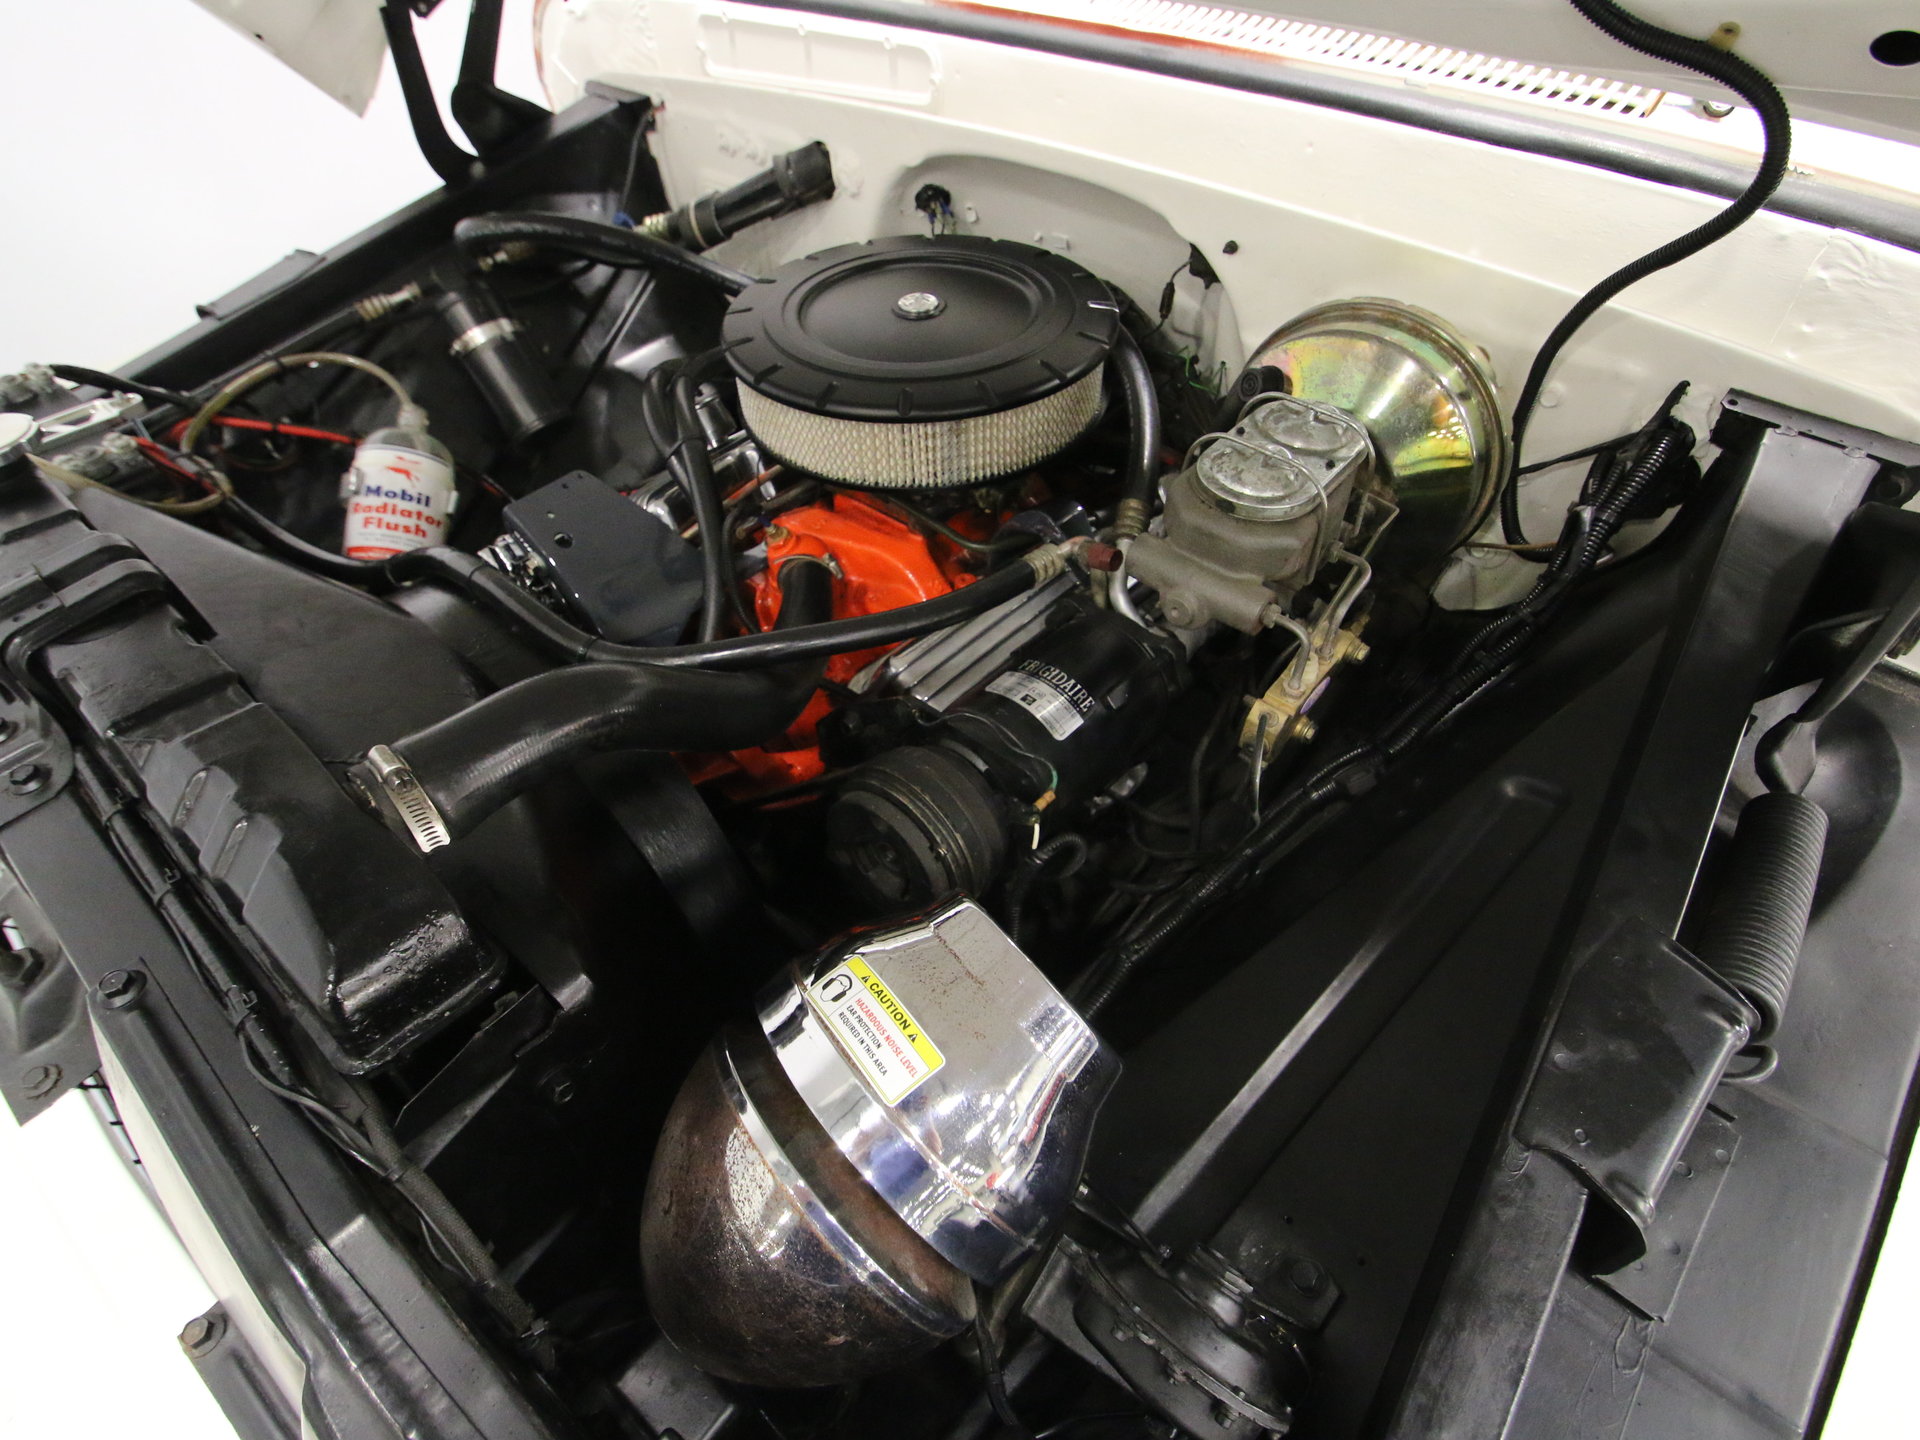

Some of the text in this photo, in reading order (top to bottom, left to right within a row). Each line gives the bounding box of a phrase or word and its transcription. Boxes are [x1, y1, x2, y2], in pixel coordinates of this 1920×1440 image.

[366, 486, 430, 507] Mobil
[363, 516, 427, 538] Flush
[1018, 659, 1095, 712] FRIGIDAIRE
[846, 1004, 882, 1049] EAR PROTECTION
[869, 982, 911, 1030] CAUTION
[838, 1011, 888, 1076] REQUIRED IN THIS AREA
[855, 998, 918, 1078] HAZARDOUS NOISE LEVEL
